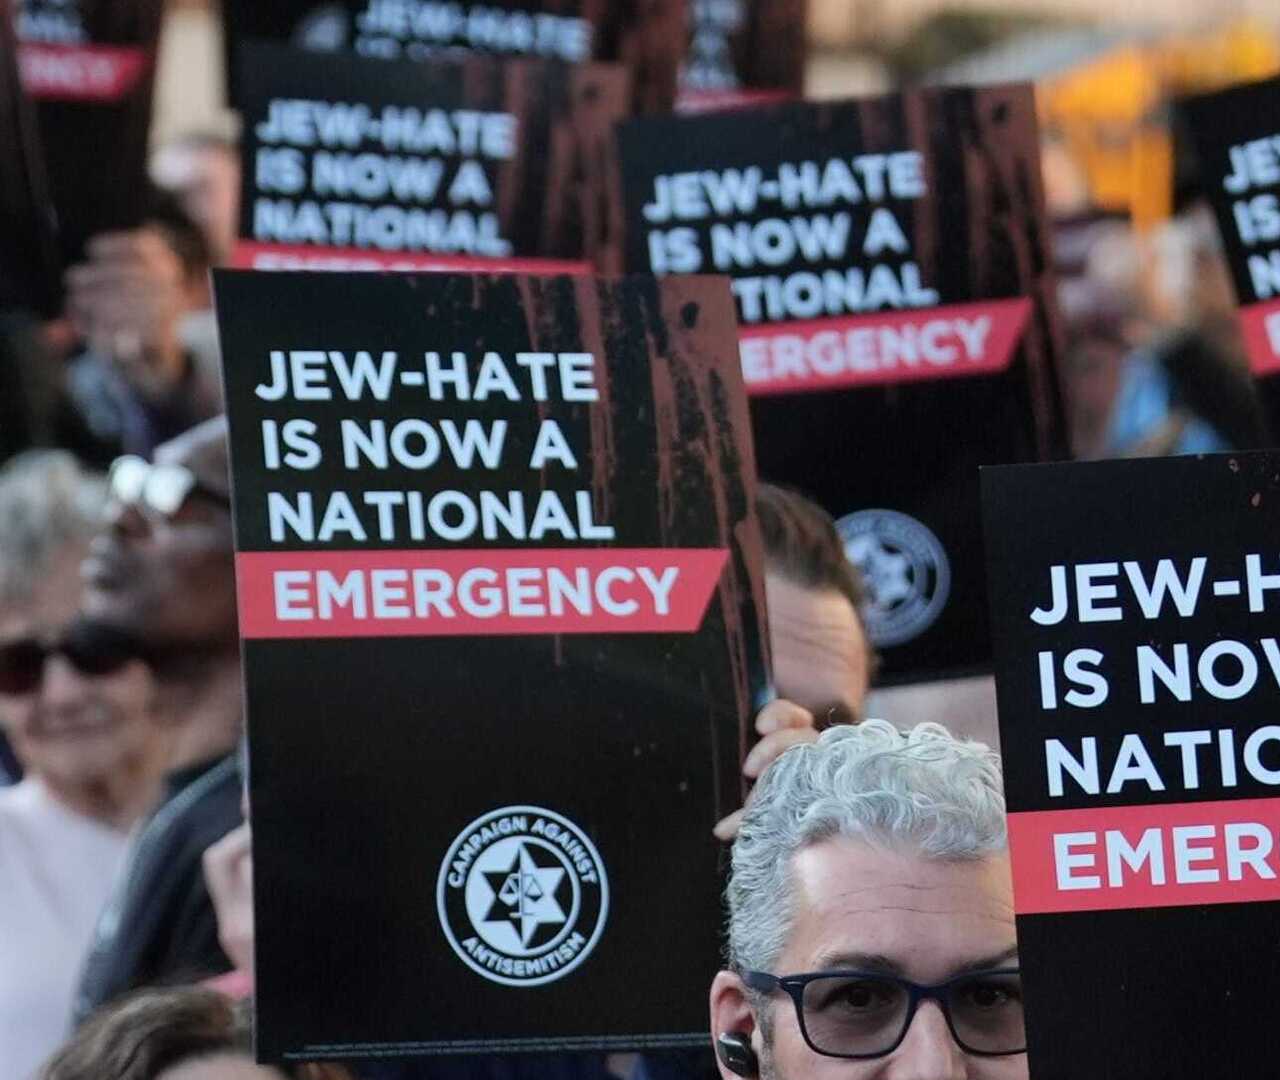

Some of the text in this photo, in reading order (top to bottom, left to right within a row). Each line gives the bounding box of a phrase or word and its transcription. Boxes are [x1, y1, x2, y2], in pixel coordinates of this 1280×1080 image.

[255, 98, 518, 160] JEW-HATE
[255, 146, 493, 207] IS NOW A
[642, 150, 926, 224] JEW-HATE
[253, 197, 513, 258] NATIONAL
[648, 207, 909, 275] IS NOW A
[731, 262, 939, 323] TIONAL
[255, 351, 599, 402] JEW-HATE
[739, 315, 992, 384] ERGENCY
[261, 419, 578, 470] IS NOW A
[267, 490, 615, 542] NATIONAL
[273, 567, 679, 621] EMERGENCY
[1038, 648, 1110, 710] IS
[448, 816, 597, 888] CAMPAIGN AGAINST
[461, 931, 587, 976] ANTISEMITISM
